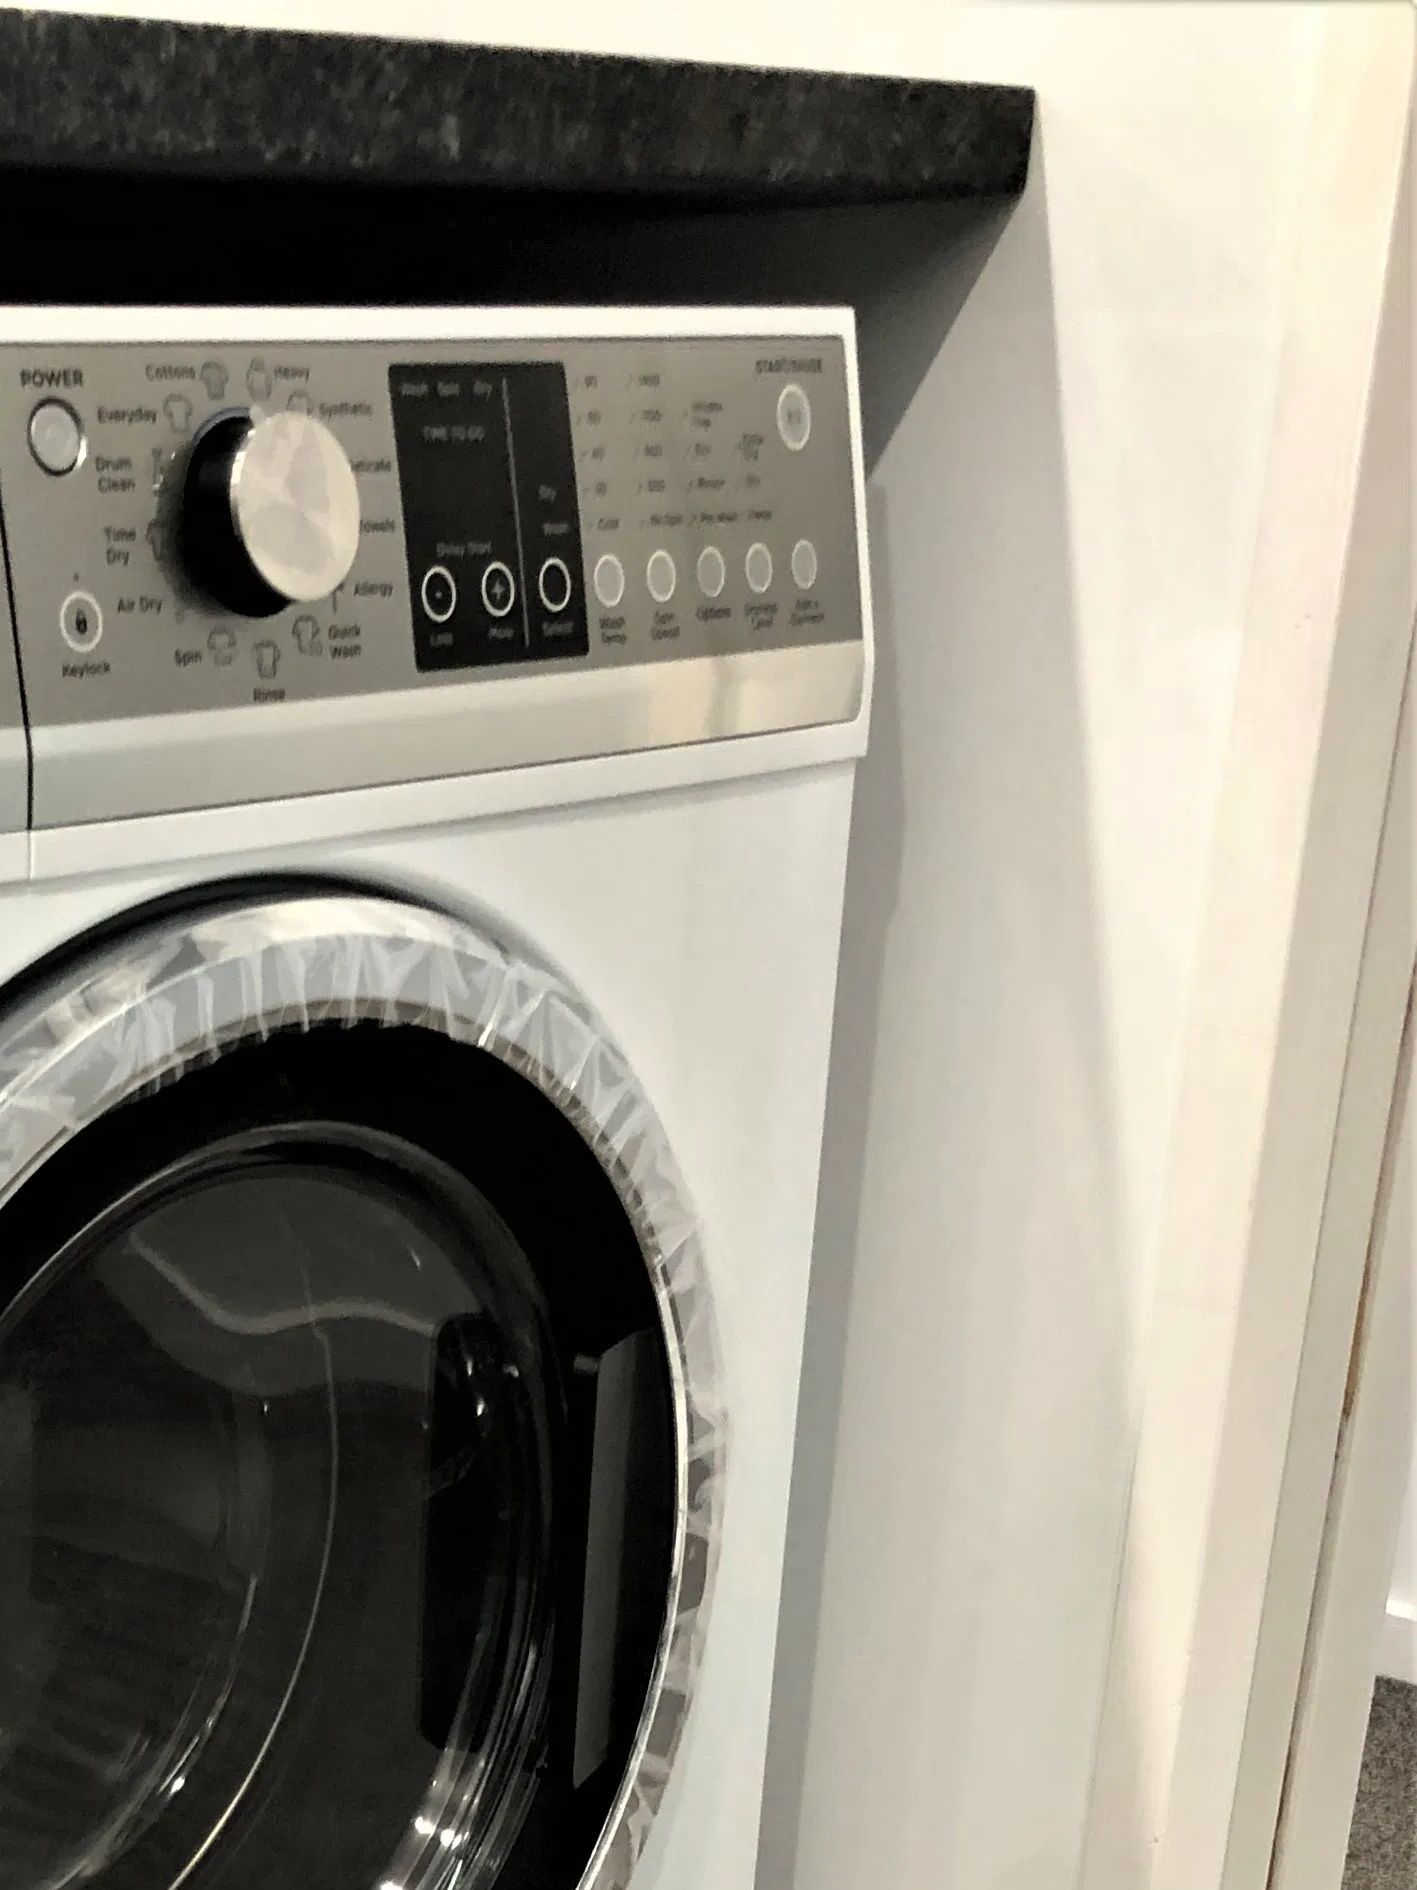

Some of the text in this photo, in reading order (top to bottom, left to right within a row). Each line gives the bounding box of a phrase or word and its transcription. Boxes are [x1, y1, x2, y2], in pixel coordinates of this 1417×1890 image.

[19, 367, 84, 388] POWER
[145, 363, 197, 382] Cottons
[97, 406, 157, 425] Everyday
[95, 456, 133, 472] Drum
[97, 476, 136, 493] Clean
[104, 526, 136, 542] Time
[106, 549, 130, 566] Dry
[117, 596, 162, 615] Air Dry
[174, 648, 202, 667] Spin
[62, 661, 111, 678] Keylock
